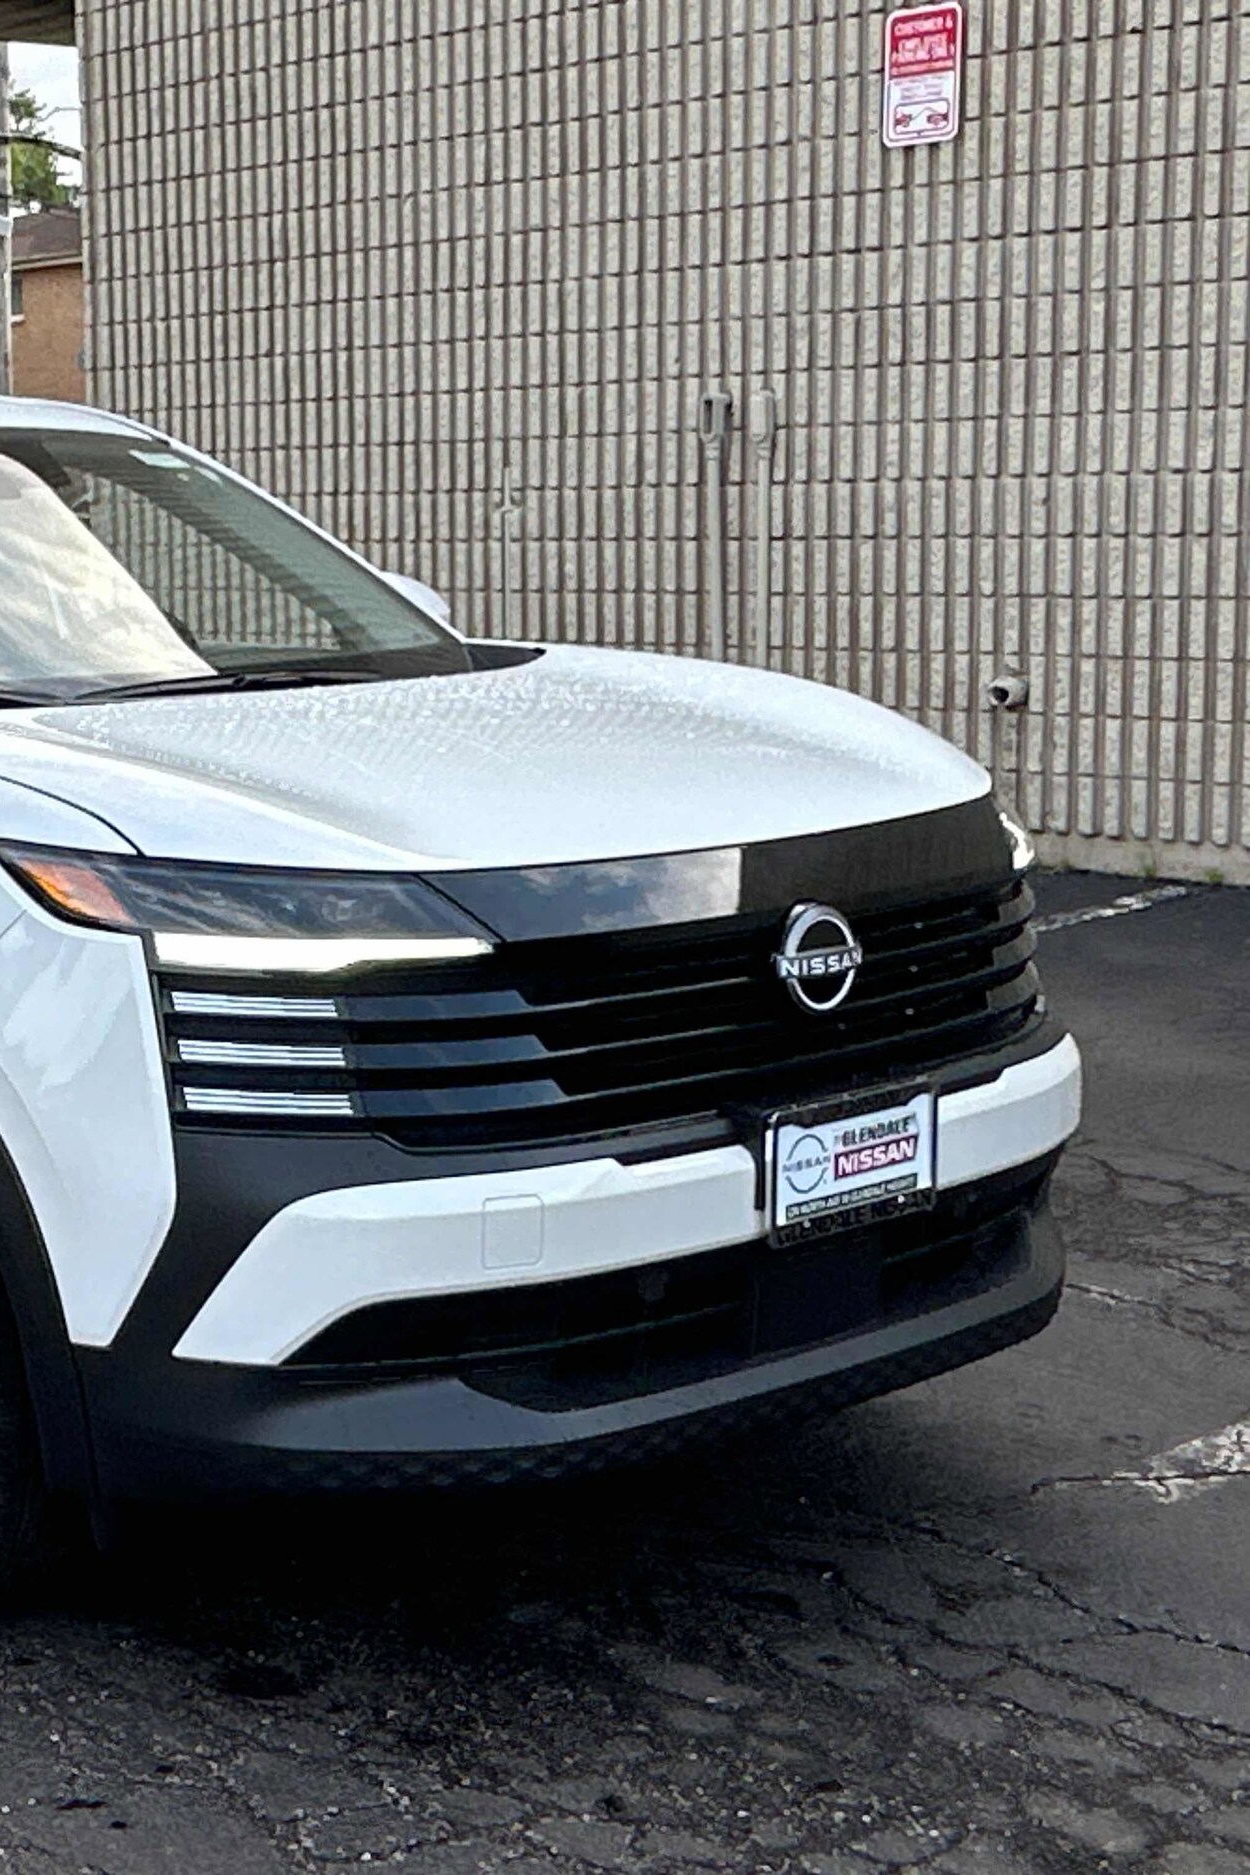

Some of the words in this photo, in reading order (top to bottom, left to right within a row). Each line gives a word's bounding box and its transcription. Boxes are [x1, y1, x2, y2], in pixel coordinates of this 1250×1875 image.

[780, 949, 862, 977] NISSAN
[842, 1116, 910, 1147] GLENDALE
[782, 1155, 831, 1173] NISSAN
[837, 1137, 915, 1176] NISSAN
